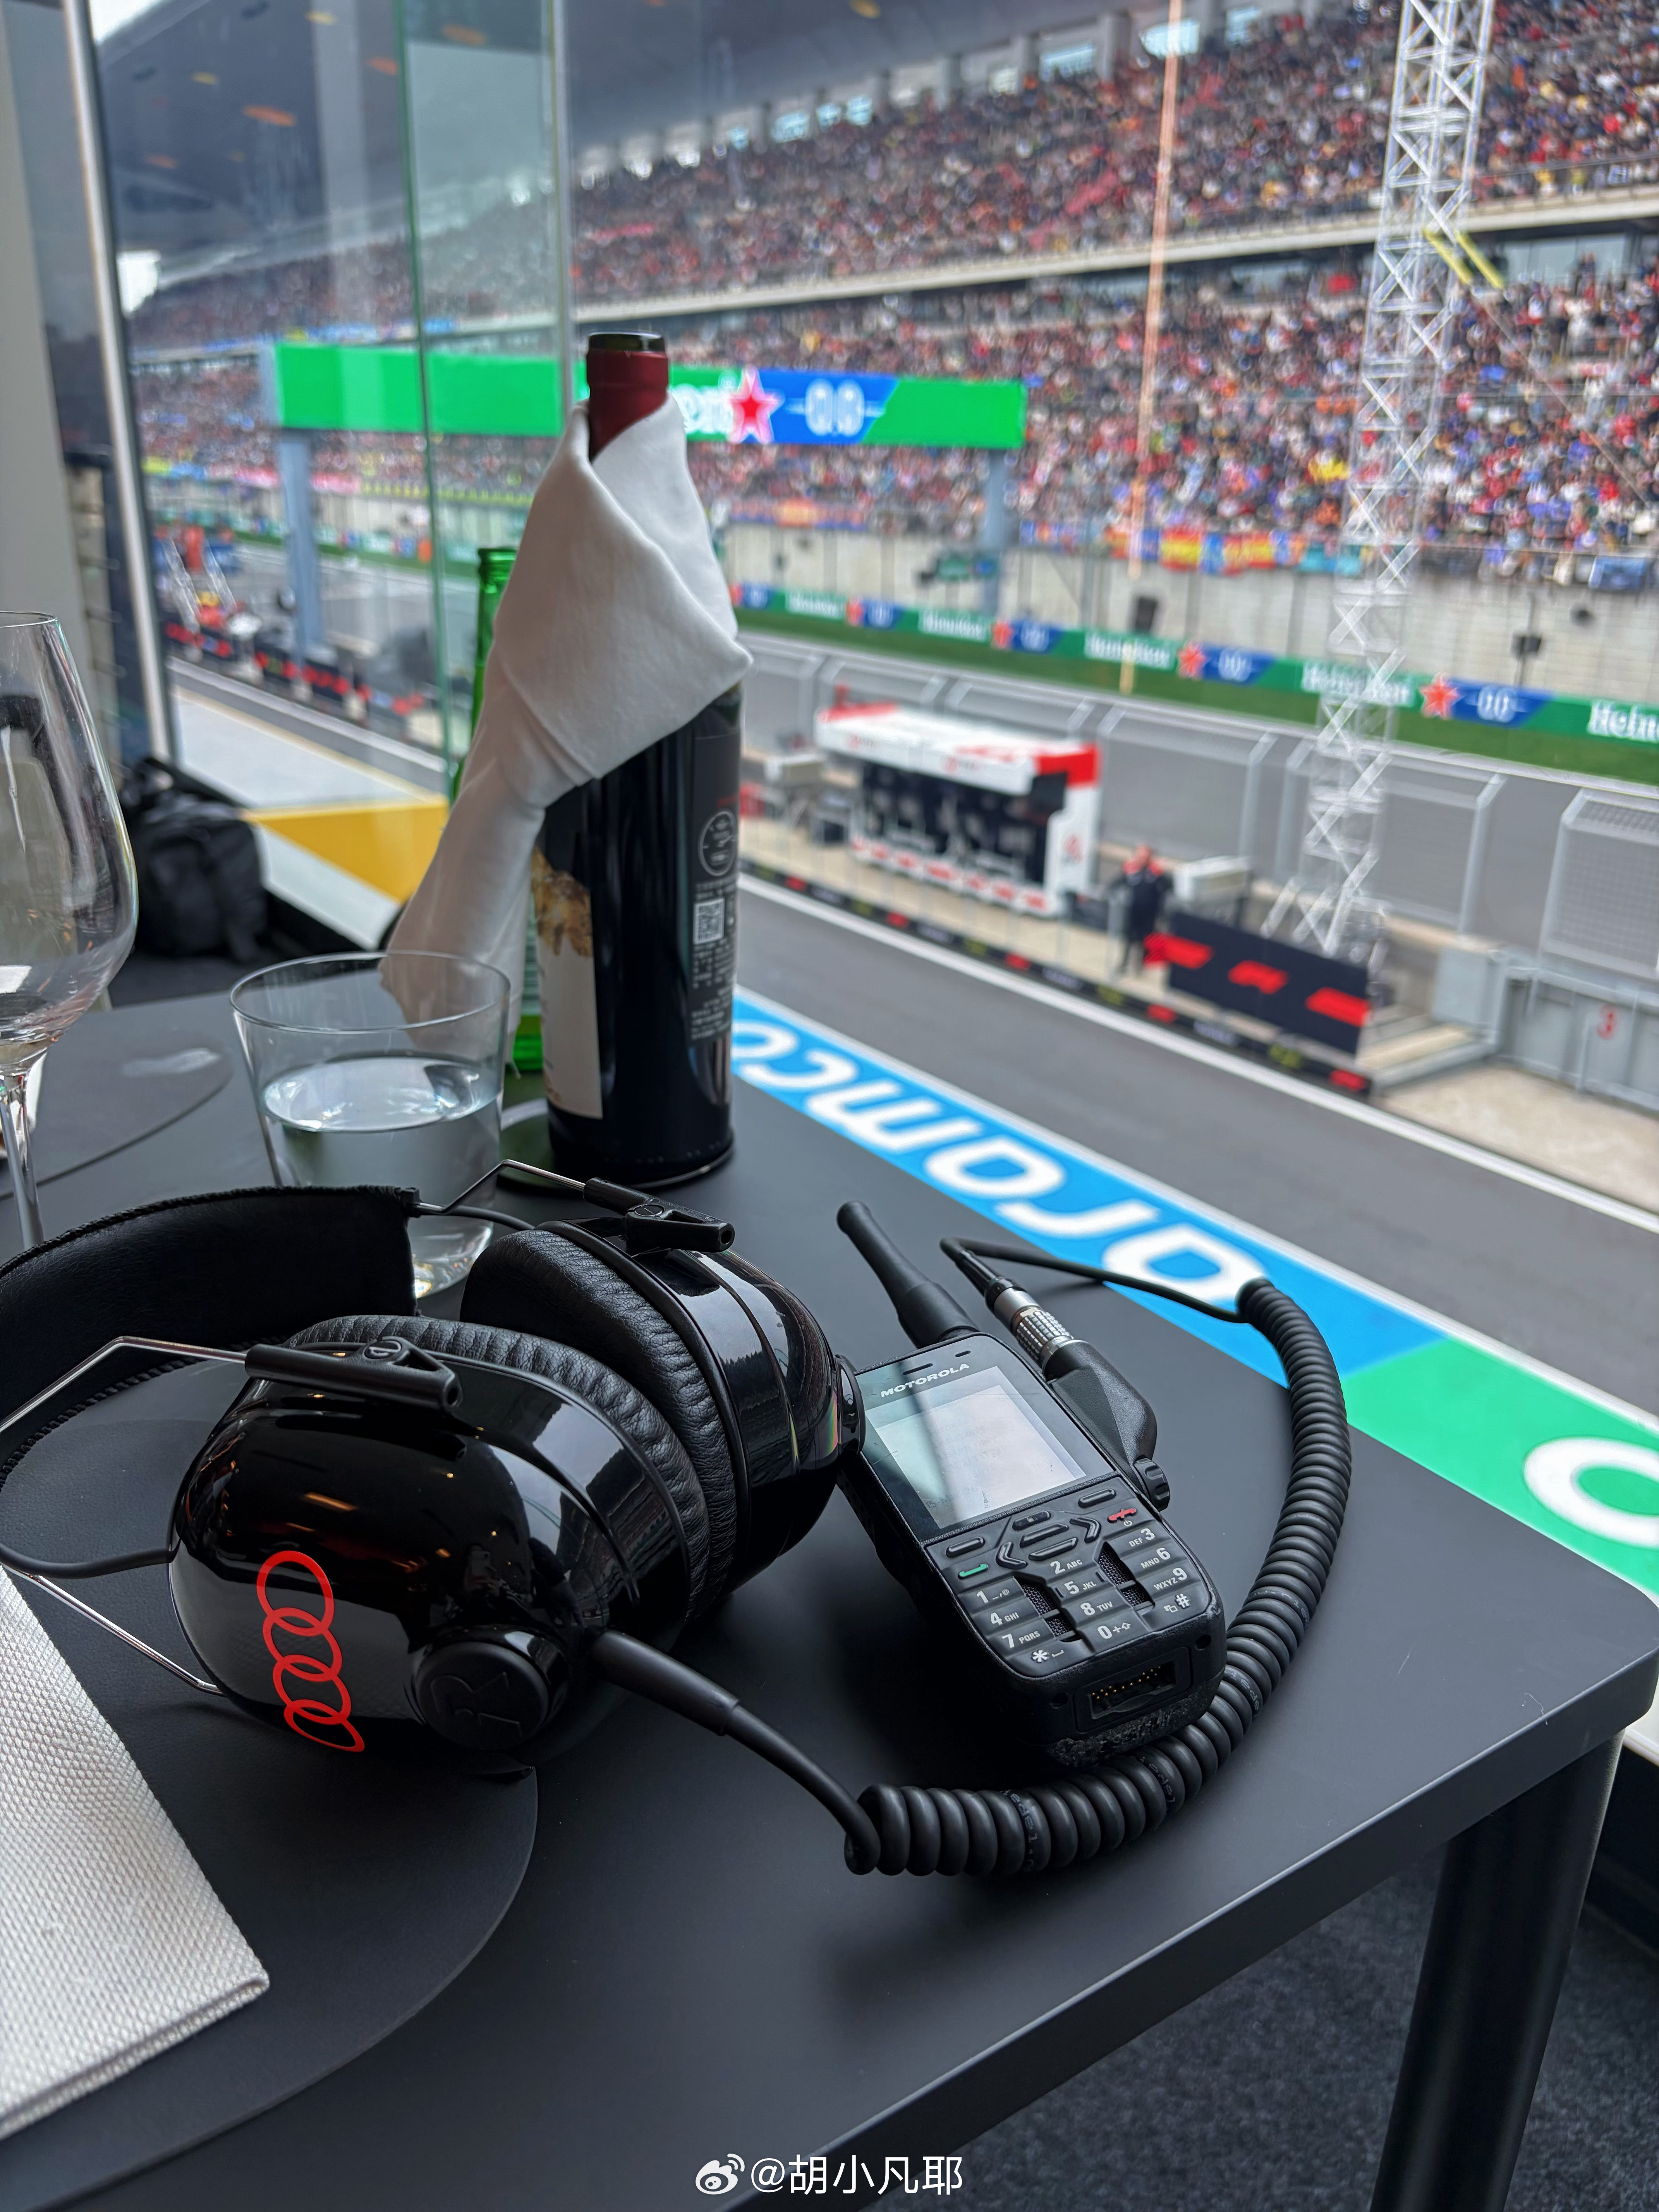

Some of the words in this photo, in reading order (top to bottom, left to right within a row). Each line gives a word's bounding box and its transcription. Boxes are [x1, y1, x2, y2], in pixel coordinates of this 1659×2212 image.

[732, 1019, 1267, 1304] aramco
[881, 1363, 970, 1398] MOTOROLA
[1128, 1537, 1143, 1547] DEF
[1140, 1528, 1155, 1540] 3
[1140, 1557, 1160, 1569] MNO
[1156, 1547, 1171, 1560] 6
[1050, 1561, 1066, 1574] 2
[1066, 1559, 1083, 1569] ABC
[1154, 1577, 1178, 1590] WXYZ
[1172, 1568, 1187, 1581] 9
[1064, 1581, 1080, 1595] 5
[1083, 1581, 1097, 1590] JKL
[976, 1591, 989, 1604] 1
[1080, 1602, 1096, 1616] 8
[1097, 1601, 1113, 1611] TUV
[990, 1612, 1003, 1626] 4
[1004, 1612, 1020, 1622] GHI
[1002, 1633, 1015, 1648] 7
[1018, 1630, 1041, 1644] PQRS
[1097, 1625, 1112, 1639] 0
